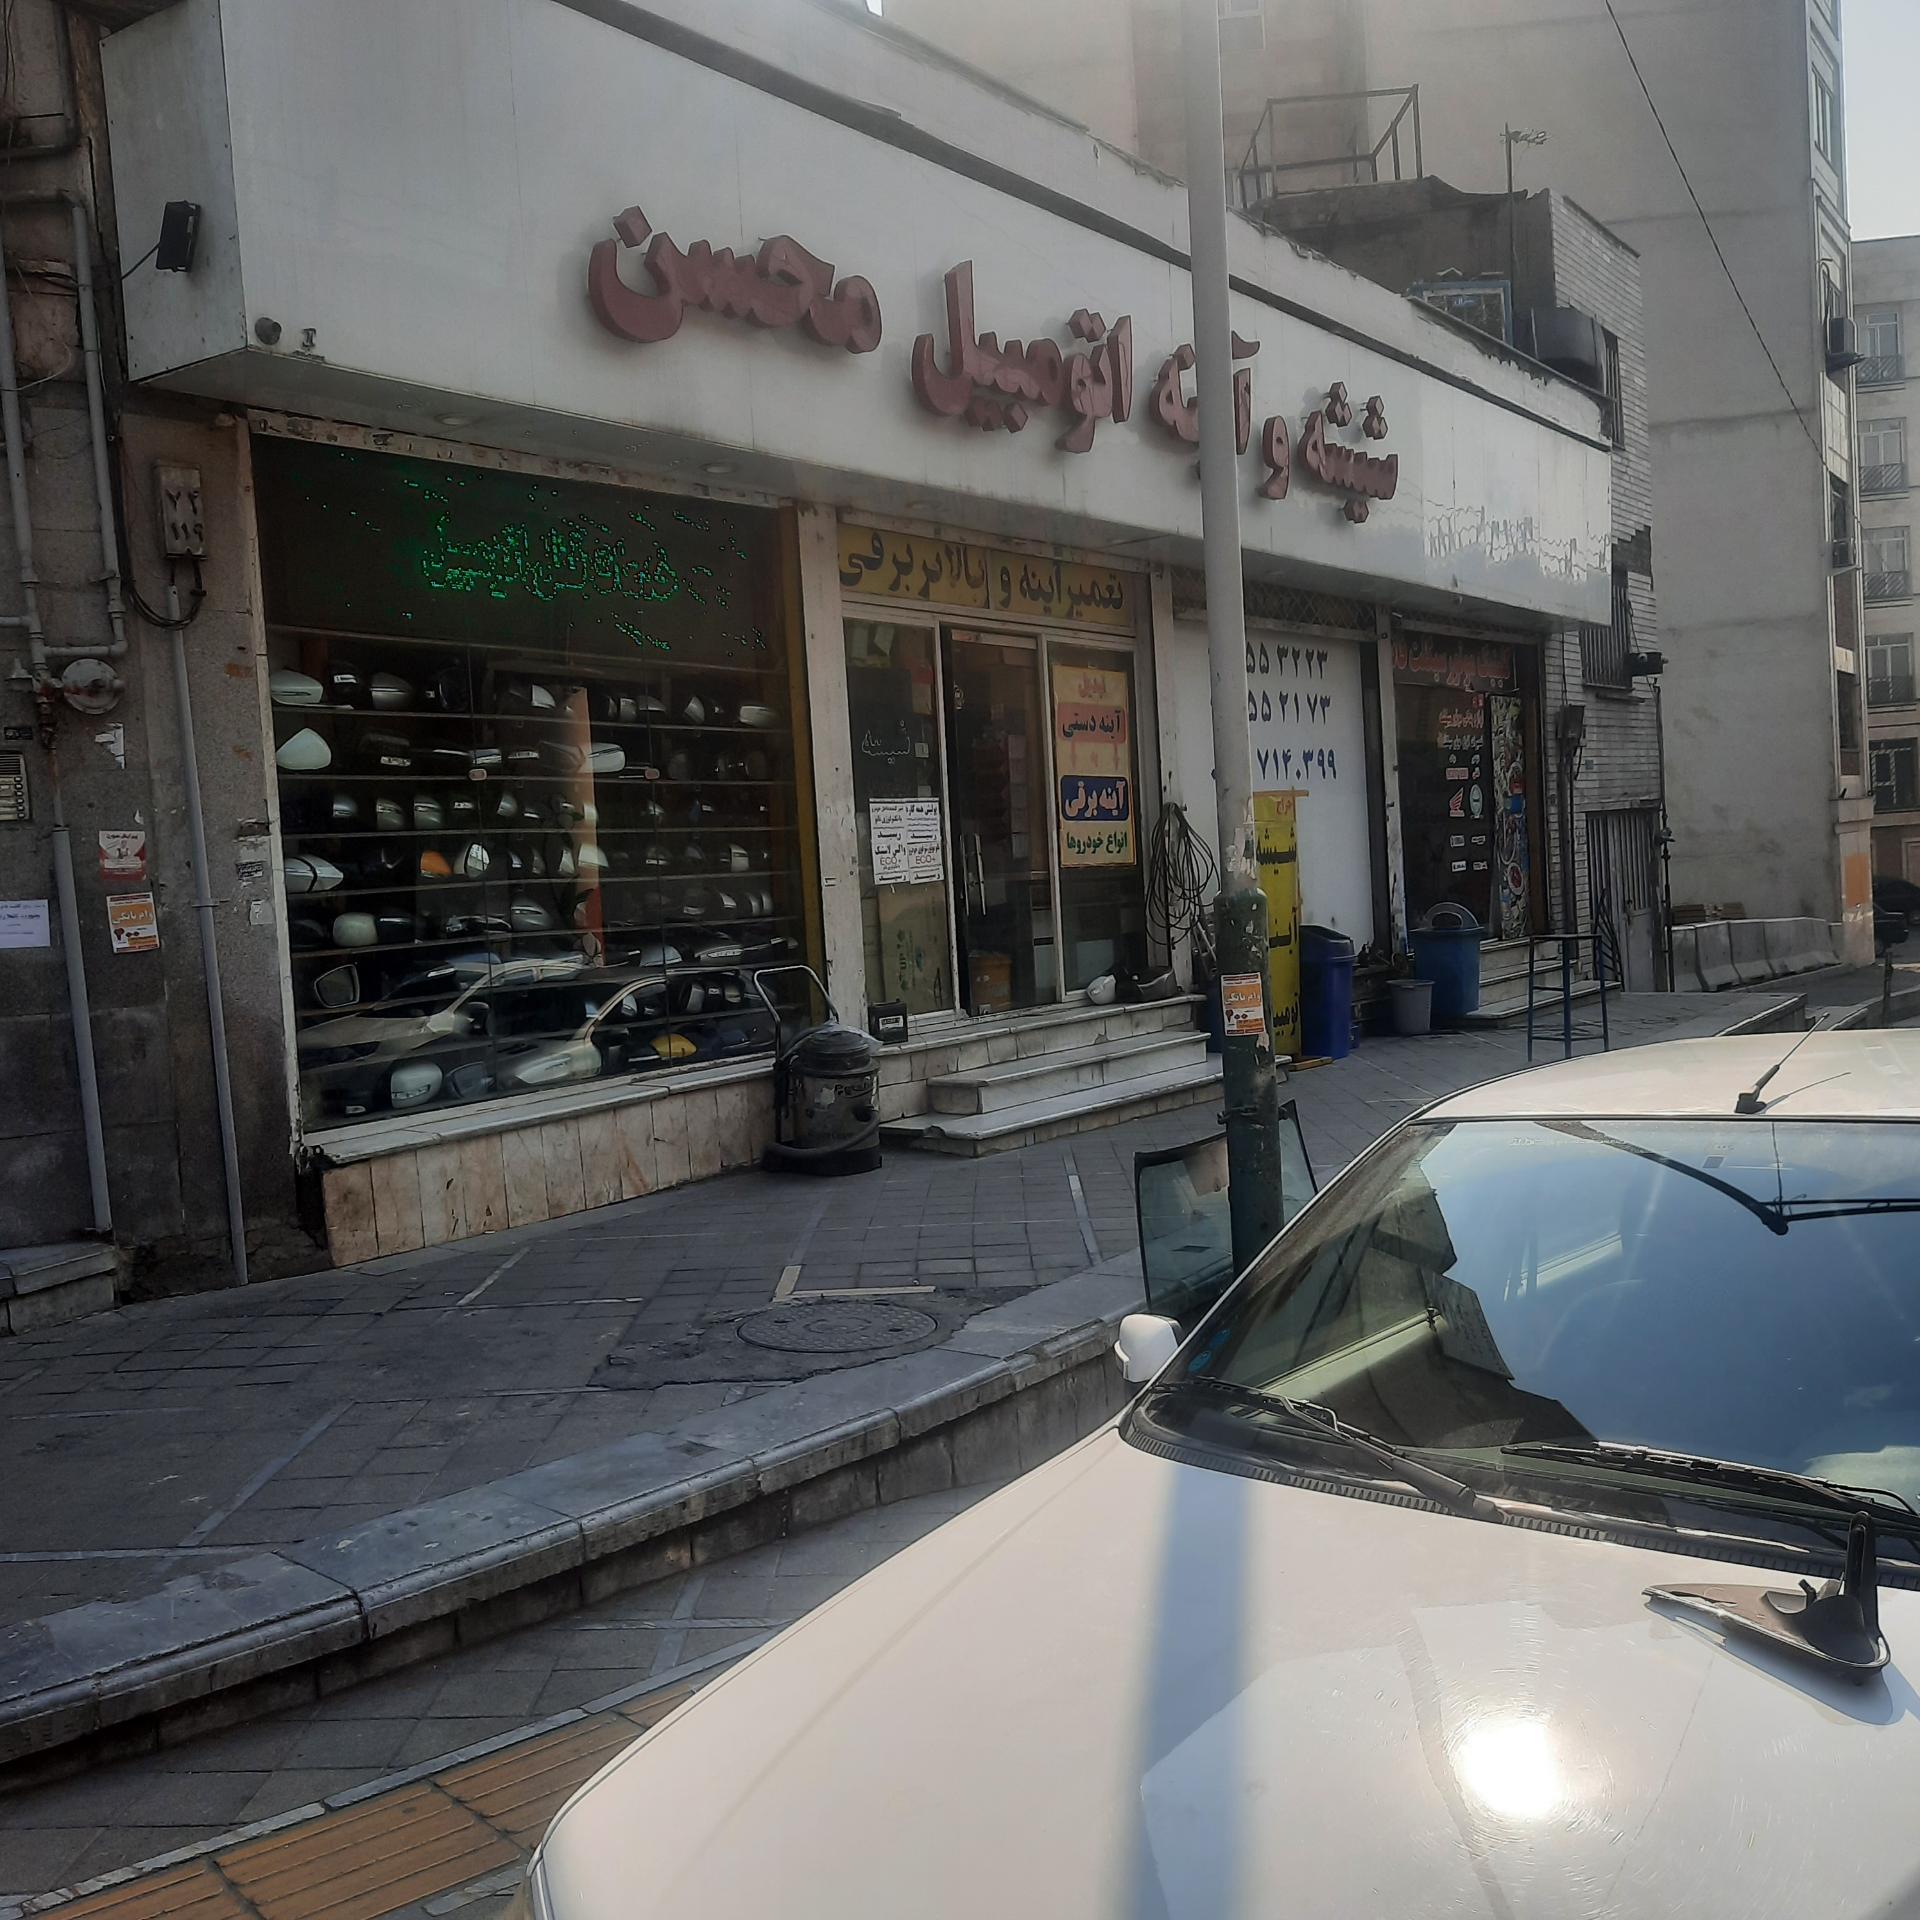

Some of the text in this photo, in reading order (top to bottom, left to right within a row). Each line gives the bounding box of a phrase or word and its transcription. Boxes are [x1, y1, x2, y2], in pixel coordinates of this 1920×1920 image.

[588, 206, 1398, 523] شیشه و آنه اتومبیل محسن
[838, 531, 913, 592] برقی
[999, 566, 1010, 608] و
[1066, 572, 1123, 618] تعمیر
[1062, 710, 1120, 739] آینه دستی
[1065, 780, 1126, 818] آینه برقی
[1066, 831, 1128, 855] انواع خودروها
